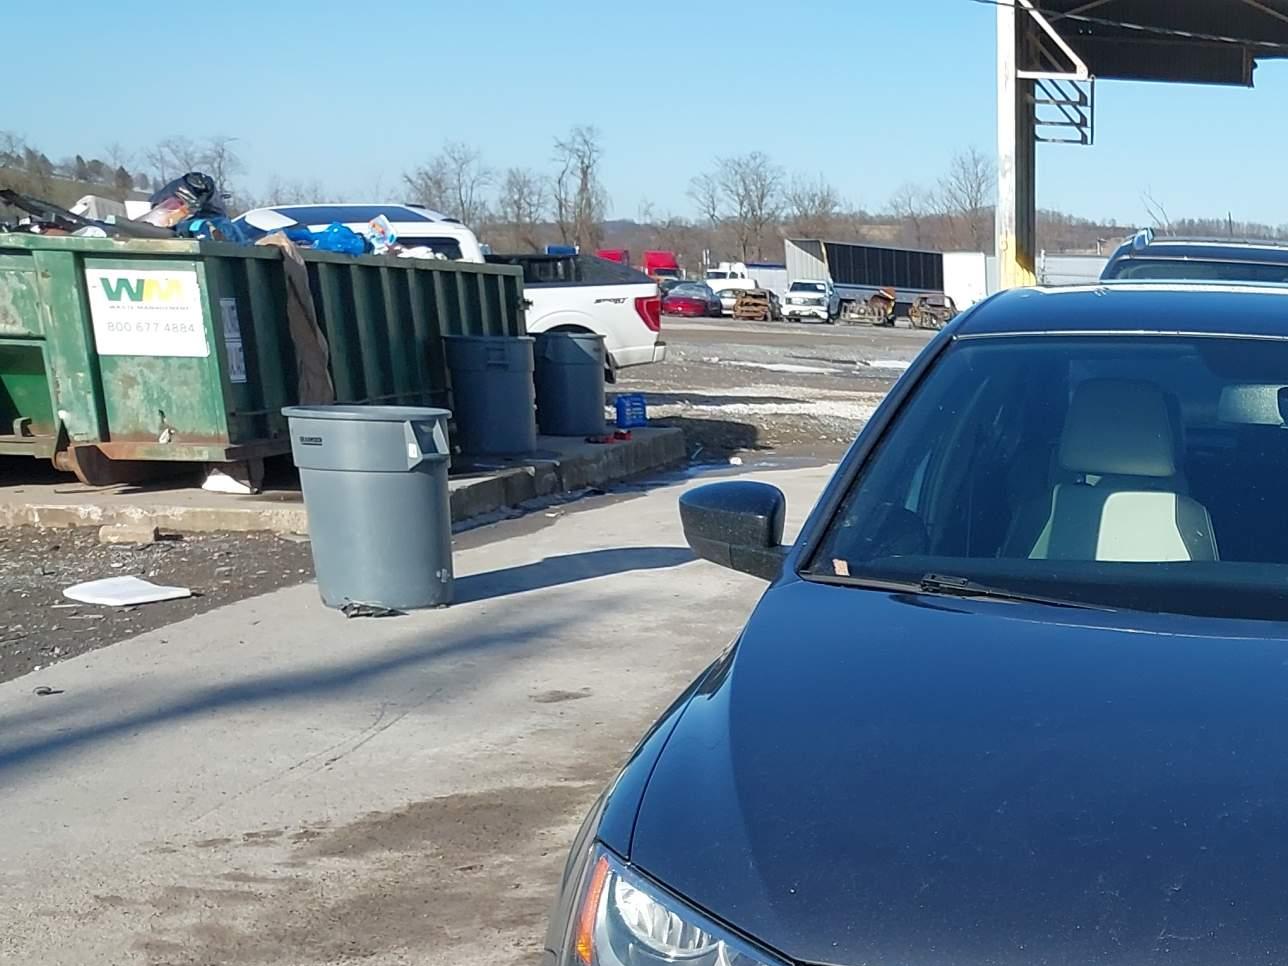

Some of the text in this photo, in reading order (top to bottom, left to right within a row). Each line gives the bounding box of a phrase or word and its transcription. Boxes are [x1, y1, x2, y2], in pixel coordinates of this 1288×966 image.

[100, 277, 184, 302] WM
[107, 321, 132, 333] 800
[136, 322, 159, 333] 677
